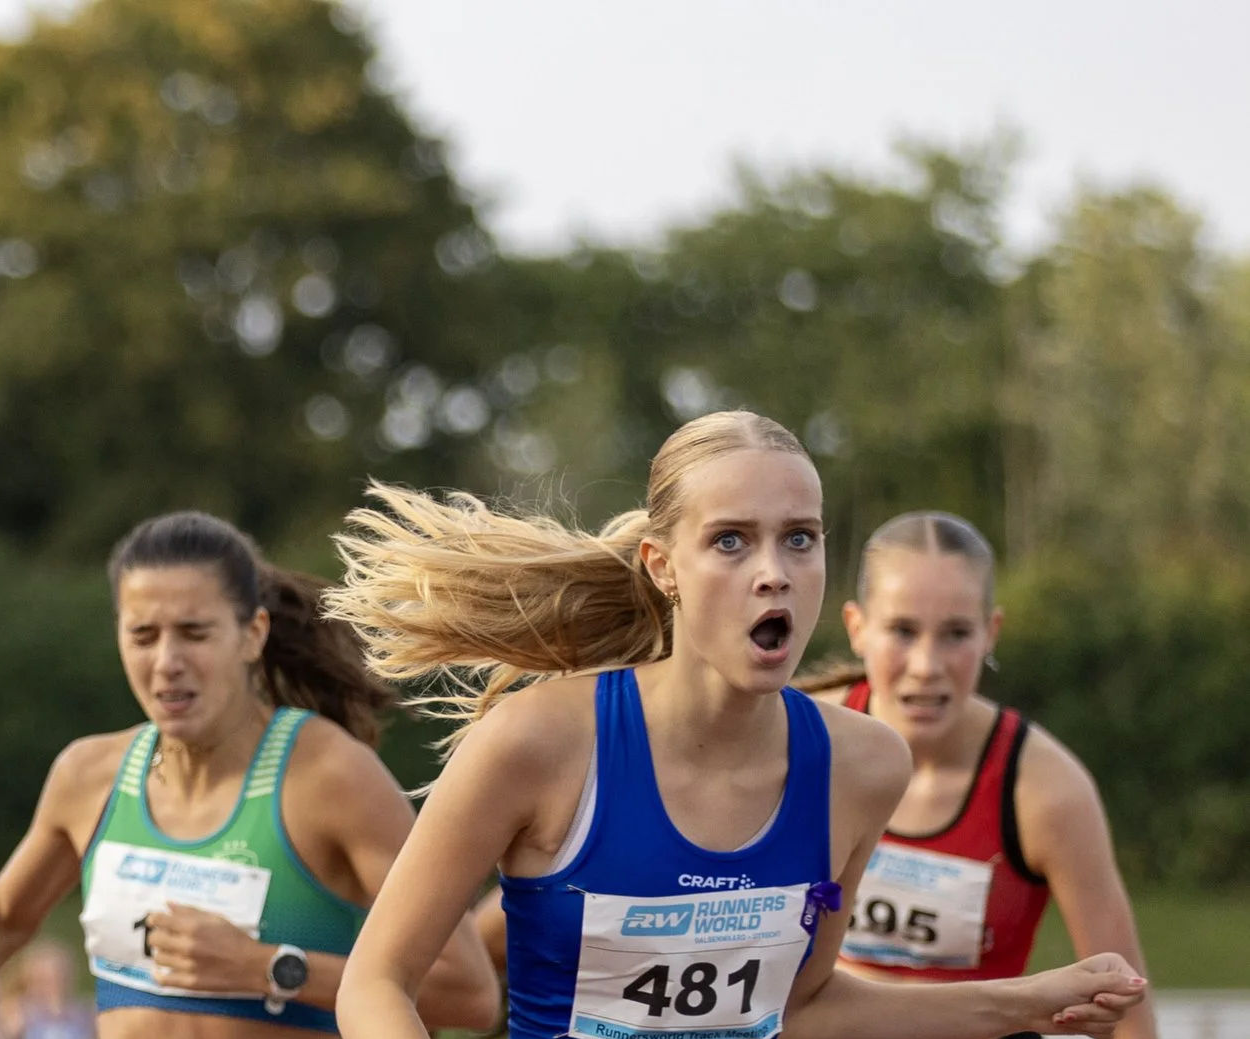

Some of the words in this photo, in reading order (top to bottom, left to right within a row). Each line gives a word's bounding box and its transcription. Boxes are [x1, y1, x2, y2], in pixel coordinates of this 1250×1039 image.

[678, 874, 738, 890] CRAFT
[697, 895, 786, 917] RUNNERS
[626, 911, 690, 929] RW
[695, 914, 762, 934] WORLD
[848, 898, 937, 944] 95
[622, 959, 761, 1017] 481
